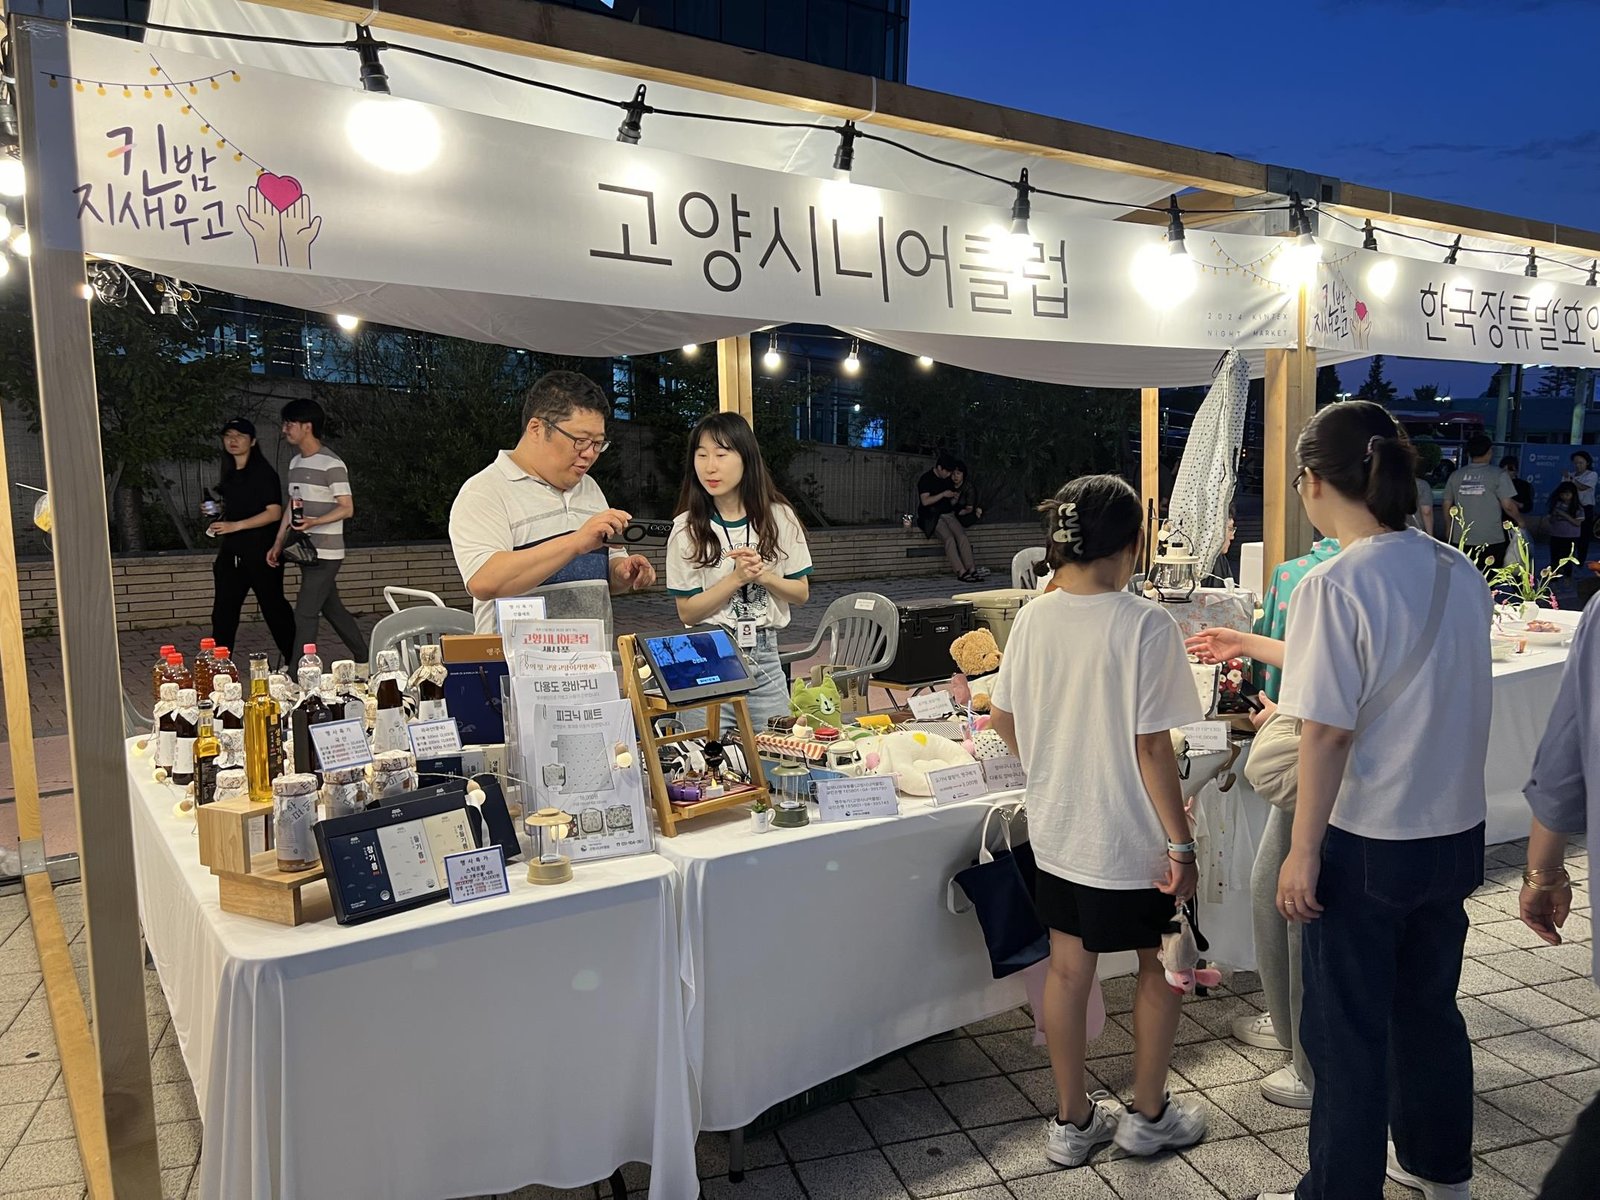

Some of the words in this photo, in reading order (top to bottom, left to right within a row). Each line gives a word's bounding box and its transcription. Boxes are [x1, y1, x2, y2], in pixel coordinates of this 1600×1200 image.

[72, 183, 234, 246] 지새우고
[588, 181, 1071, 321] 고양시니어클럽
[1207, 312, 1242, 321] 2024
[1252, 312, 1288, 321] KINTEX
[1314, 313, 1349, 341] 지새우고
[1207, 330, 1241, 338] NIGHT
[522, 633, 589, 645] 고양시니어클럽
[534, 681, 560, 692] 다용도
[562, 679, 598, 692] 장바구니
[556, 709, 580, 721] 피크닉
[584, 708, 603, 720] 매트
[366, 846, 378, 871] 참기름
